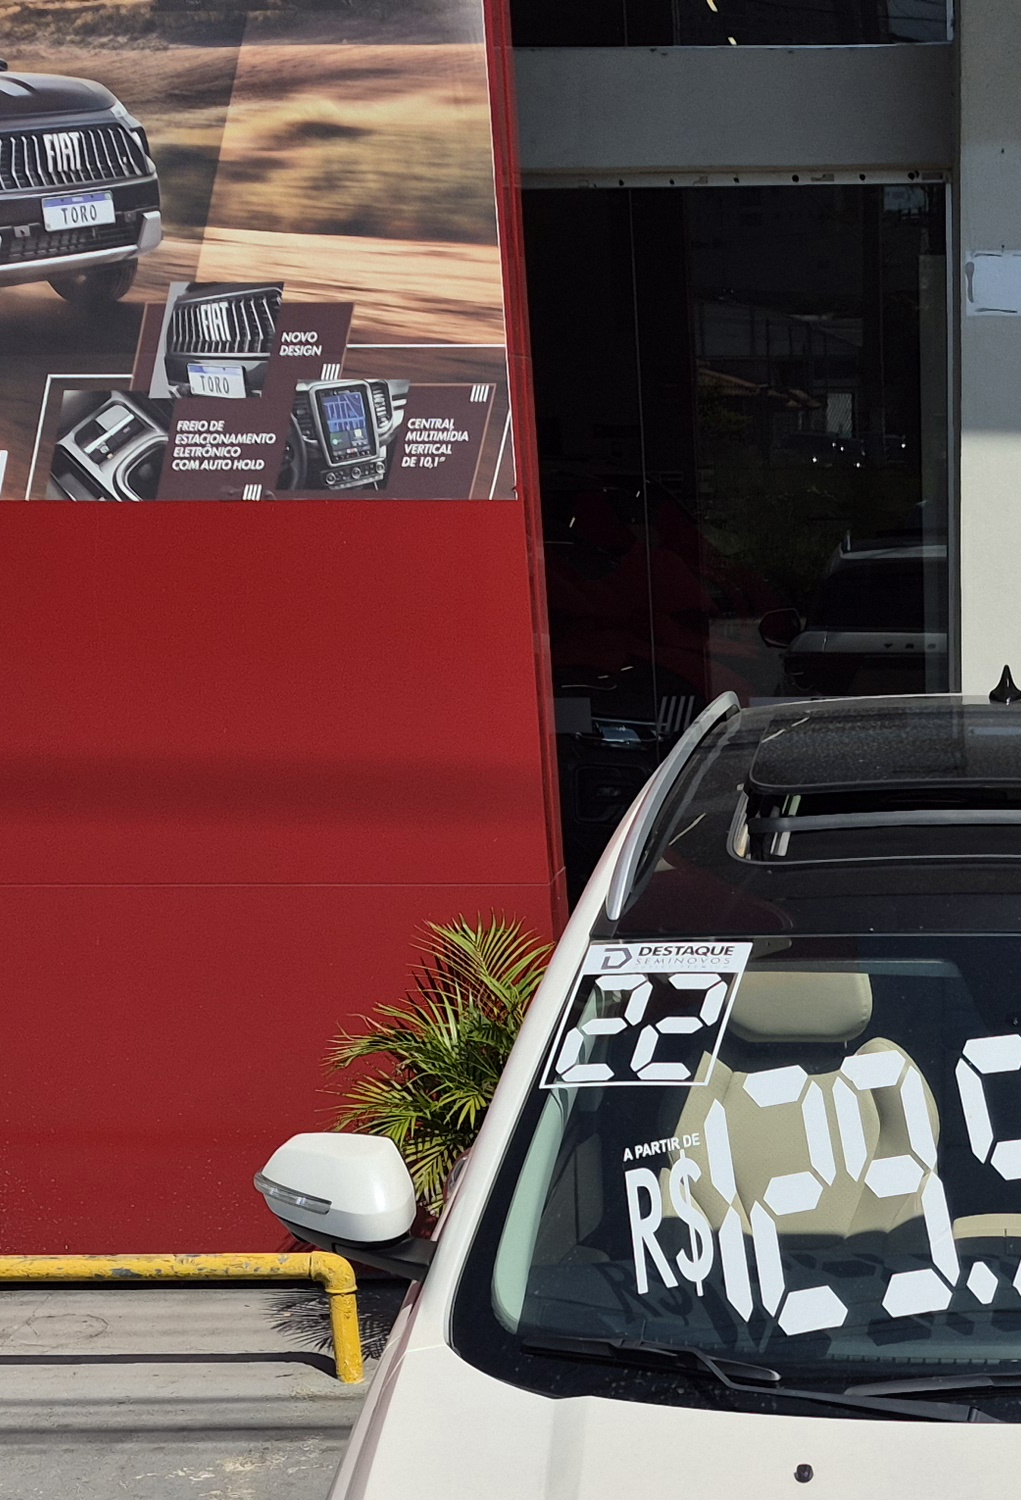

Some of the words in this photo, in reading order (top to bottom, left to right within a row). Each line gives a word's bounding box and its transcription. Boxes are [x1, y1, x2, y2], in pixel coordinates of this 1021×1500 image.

[42, 132, 80, 173] FIAT
[61, 204, 97, 225] TORO
[201, 301, 231, 341] FIAT
[281, 331, 318, 343] NOVO
[279, 345, 322, 356] DESIGN
[200, 375, 230, 394] TORO
[177, 420, 208, 431] FREIO
[209, 420, 225, 431] DE
[407, 418, 455, 429] CENTRAL
[175, 433, 276, 444] ESTACIONAMENTO
[405, 428, 469, 441] MULTIMÍDIA
[173, 444, 241, 457] ELETRÔNICO
[404, 444, 452, 454] VERTICAL
[172, 459, 199, 471] COM
[200, 459, 232, 470] AUTO
[233, 459, 265, 470] HOLD
[401, 456, 417, 467] DE
[638, 946, 735, 957] DESTAQUE
[635, 957, 731, 965] SEMINOVOS
[556, 973, 729, 1082] 22
[623, 1148, 633, 1162] A
[635, 1136, 680, 1158] PARTIR
[682, 1133, 700, 1147] DE
[625, 1149, 714, 1297] R$
